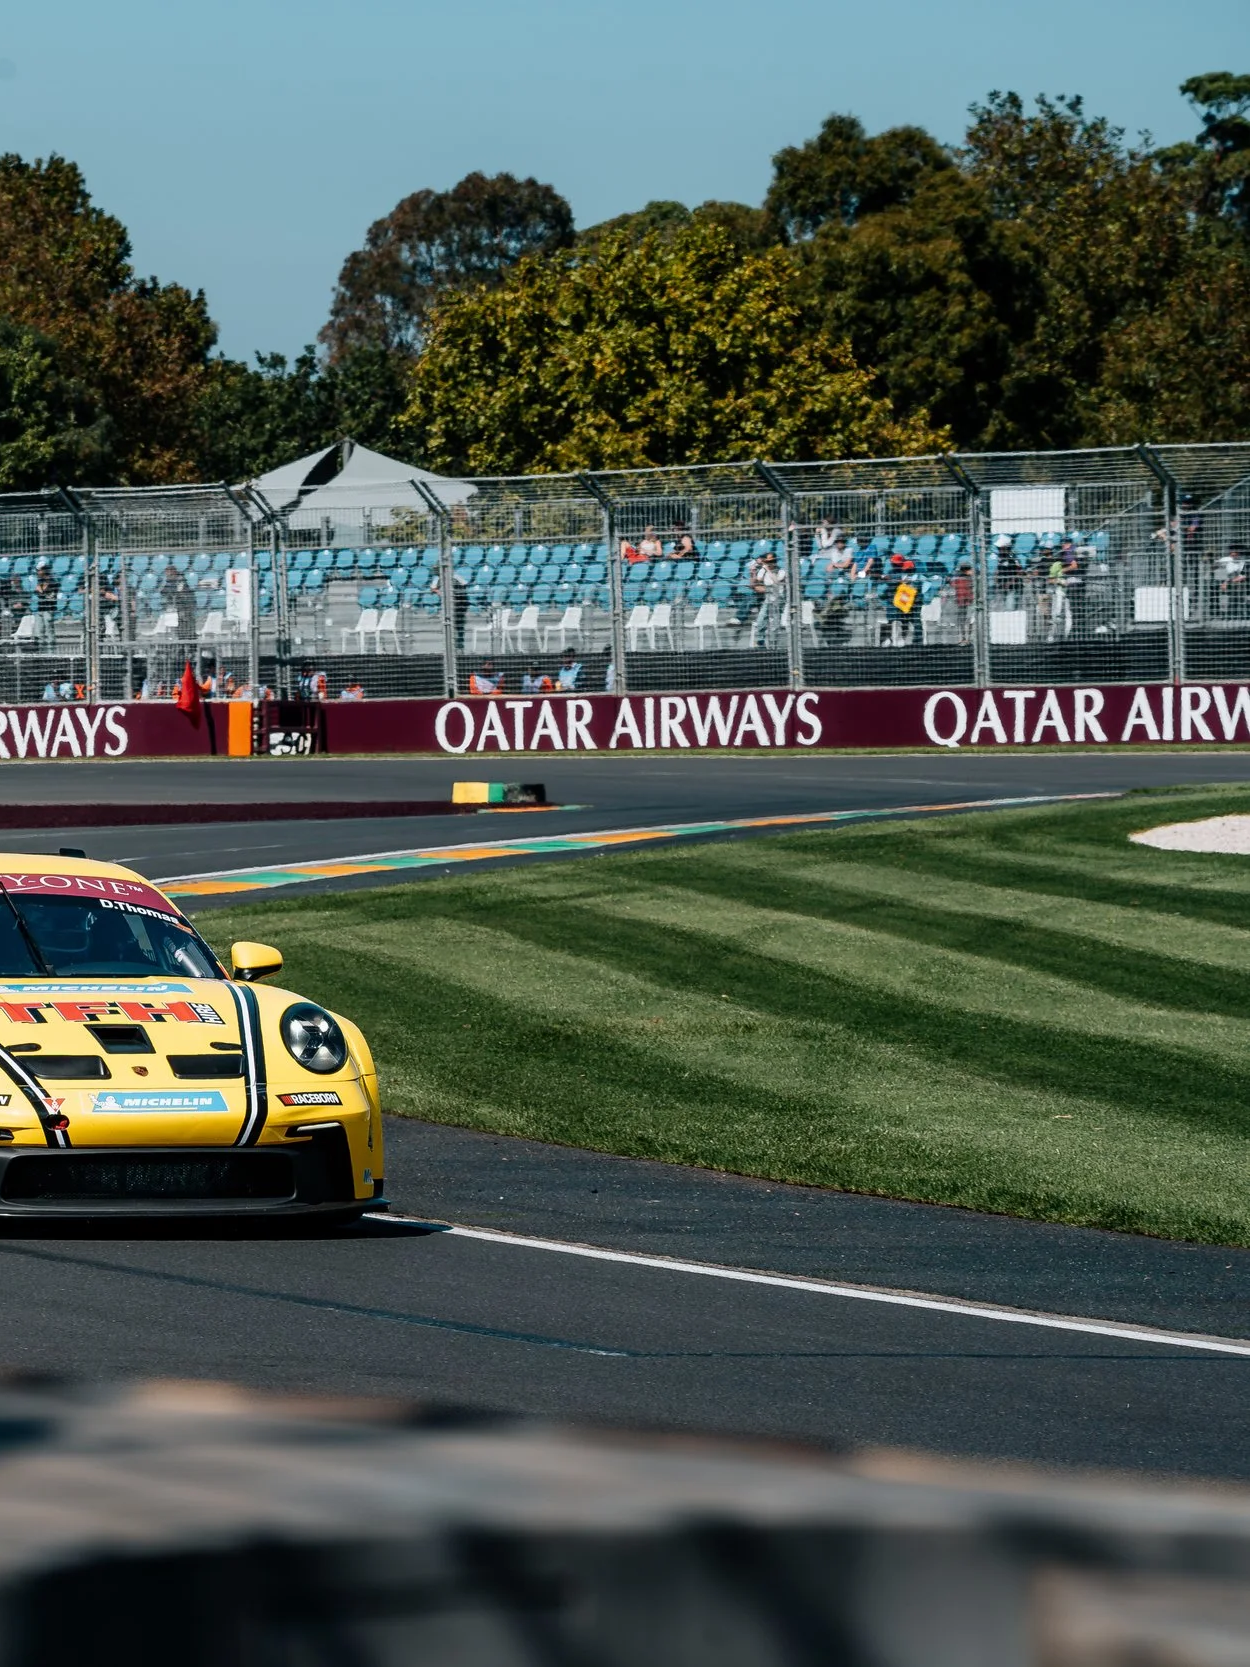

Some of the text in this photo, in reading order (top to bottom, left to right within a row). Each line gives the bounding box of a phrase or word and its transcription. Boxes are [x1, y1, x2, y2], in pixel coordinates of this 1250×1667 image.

[435, 692, 823, 754] QATAR AIRWAYS
[923, 688, 1108, 748] QATAR
[22, 984, 168, 992] MICHELIN
[123, 1097, 213, 1107] MICHELIN
[291, 1093, 340, 1105] RACEBORN
